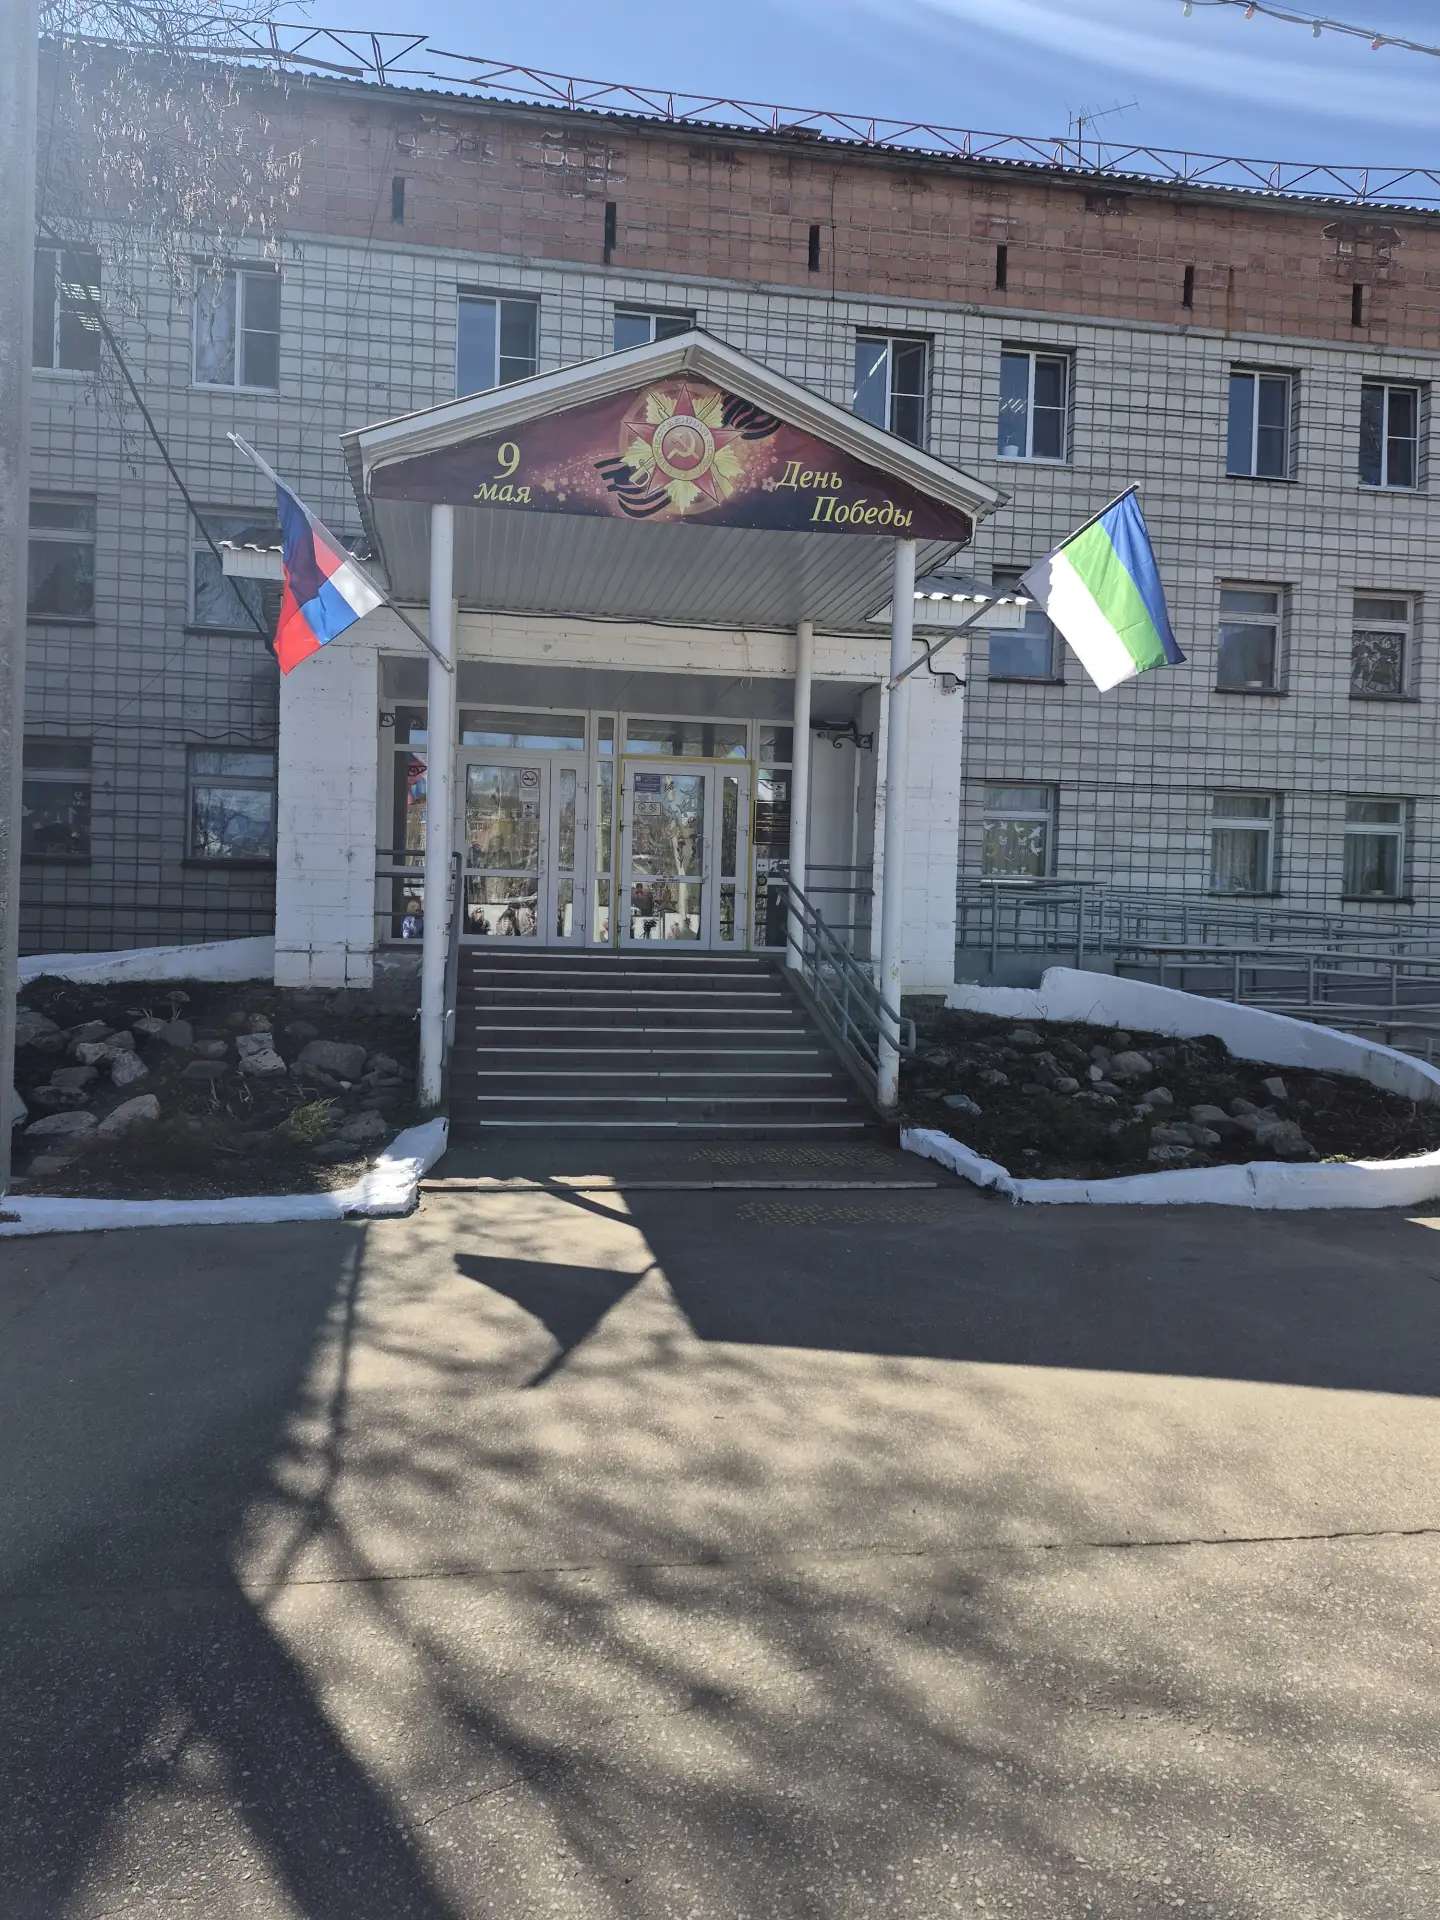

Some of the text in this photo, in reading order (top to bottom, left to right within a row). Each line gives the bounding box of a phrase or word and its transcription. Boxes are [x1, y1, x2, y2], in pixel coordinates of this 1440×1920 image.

[494, 441, 520, 479] 9
[775, 460, 843, 492] День
[473, 482, 532, 504] мая
[809, 496, 913, 527] Победы
